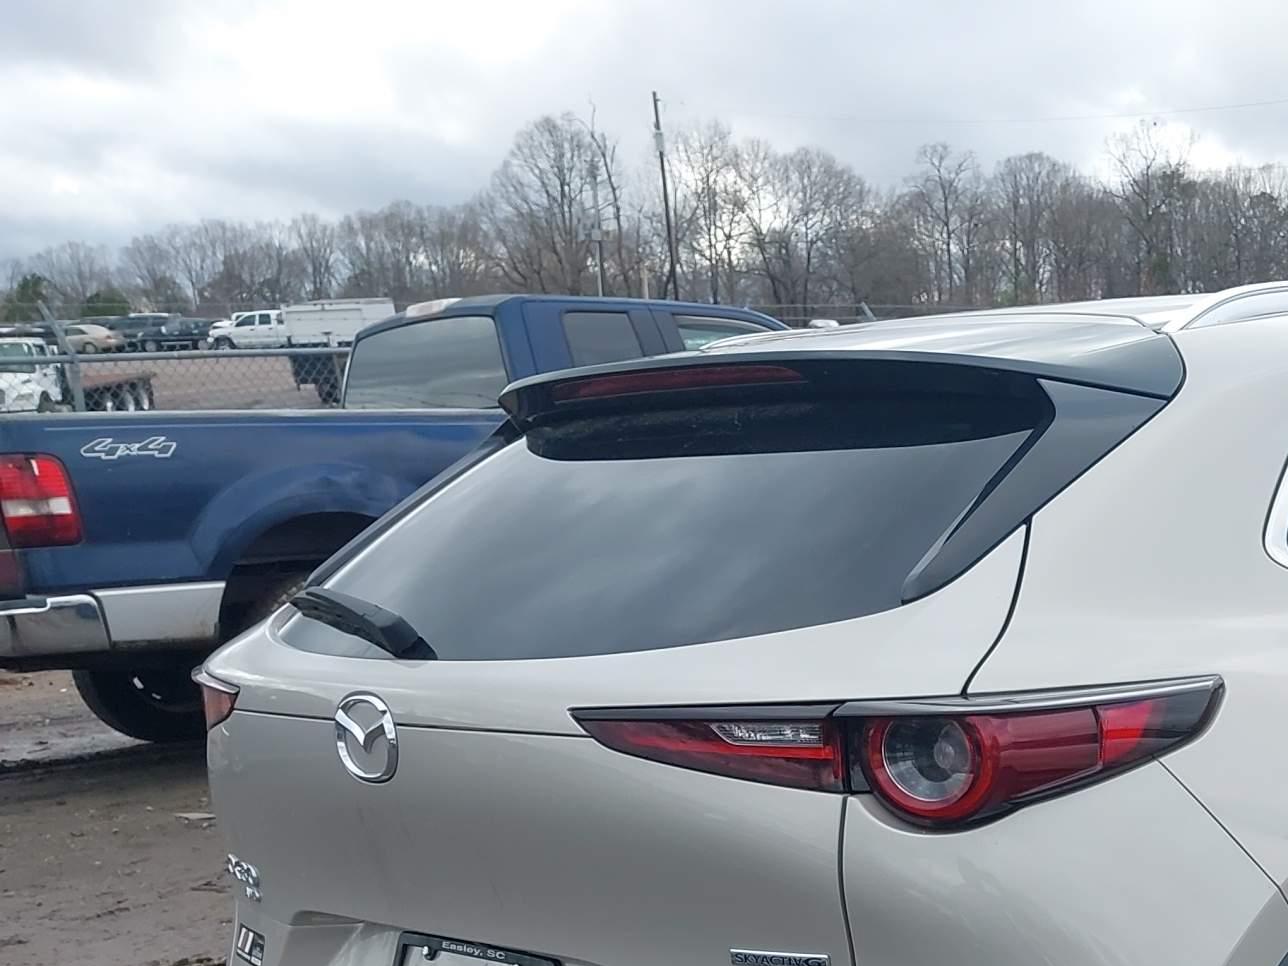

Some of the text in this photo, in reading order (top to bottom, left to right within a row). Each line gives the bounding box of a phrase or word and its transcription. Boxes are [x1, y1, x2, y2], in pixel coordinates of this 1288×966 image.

[80, 436, 177, 460] 4x4
[442, 941, 506, 960] Easley, SC
